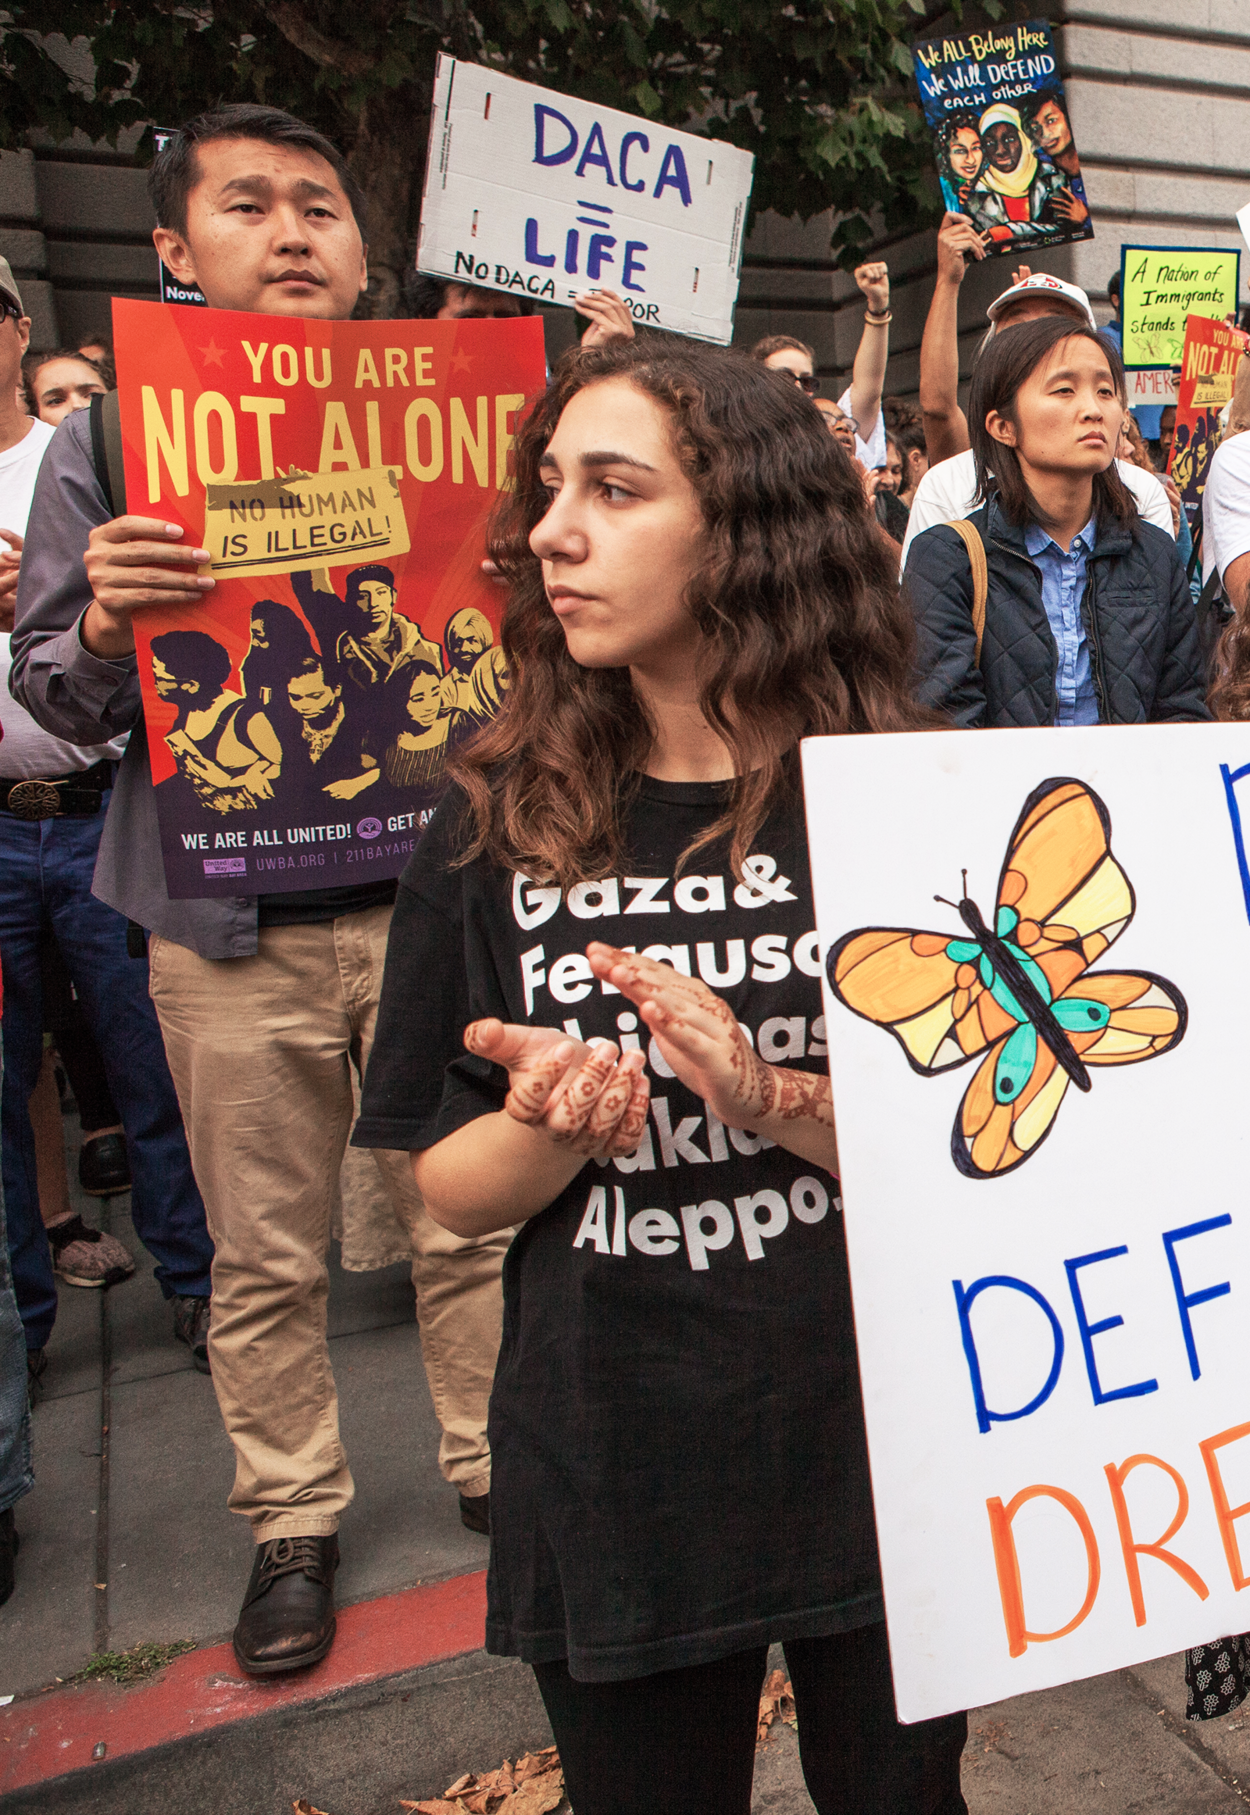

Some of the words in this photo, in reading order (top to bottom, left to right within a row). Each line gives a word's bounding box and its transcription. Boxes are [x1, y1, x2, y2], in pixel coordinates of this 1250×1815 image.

[917, 45, 942, 69] We
[943, 39, 971, 63] ALL
[969, 30, 1016, 61] Belong
[922, 73, 948, 97] We
[948, 63, 985, 91] Will
[531, 103, 692, 207] DACA
[525, 217, 649, 292] LIFE
[1131, 257, 1149, 283] A
[1203, 264, 1223, 283] of
[495, 264, 556, 299] DACA
[1140, 287, 1225, 311] Immigrants
[1212, 328, 1230, 347] YOU
[241, 340, 332, 389] YOU
[354, 346, 436, 388] ARE
[1185, 341, 1219, 381] NOT
[141, 384, 286, 504] NOT
[318, 393, 527, 493] ALONE
[229, 498, 267, 524] NO
[279, 486, 377, 520] HUMAN
[222, 534, 249, 559] IS
[267, 515, 392, 553] ILLEGAL!
[181, 833, 210, 850] WE
[214, 831, 248, 850] ARE
[252, 829, 284, 847] ALL
[287, 823, 352, 844] UNITED!
[387, 813, 416, 832] GET
[256, 853, 326, 871] UWBA.ORG
[346, 838, 419, 863] 211BAYARE
